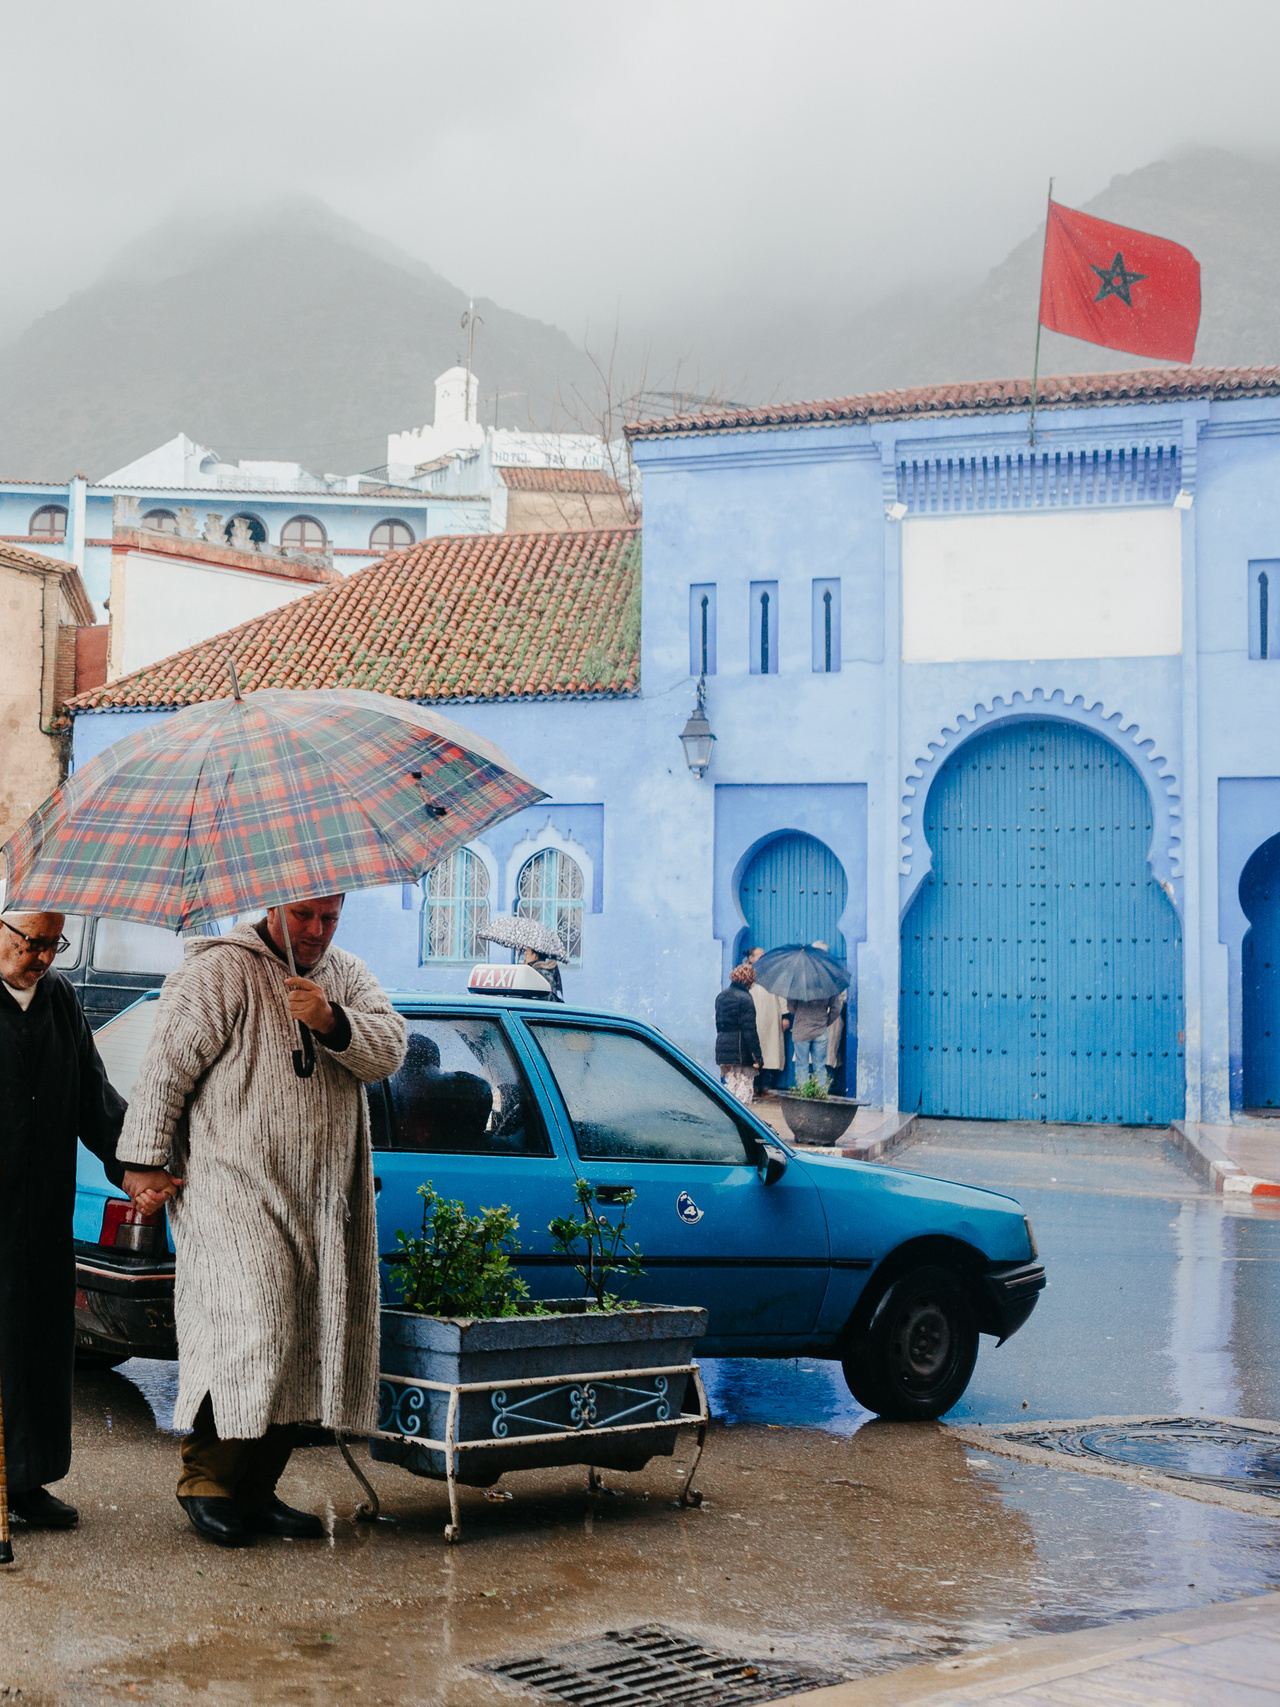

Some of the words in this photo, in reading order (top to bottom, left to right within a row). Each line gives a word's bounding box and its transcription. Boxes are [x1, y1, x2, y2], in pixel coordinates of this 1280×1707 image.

[495, 452, 531, 464] HOTEL
[474, 968, 515, 988] TAXI
[684, 1205, 697, 1216] 4
